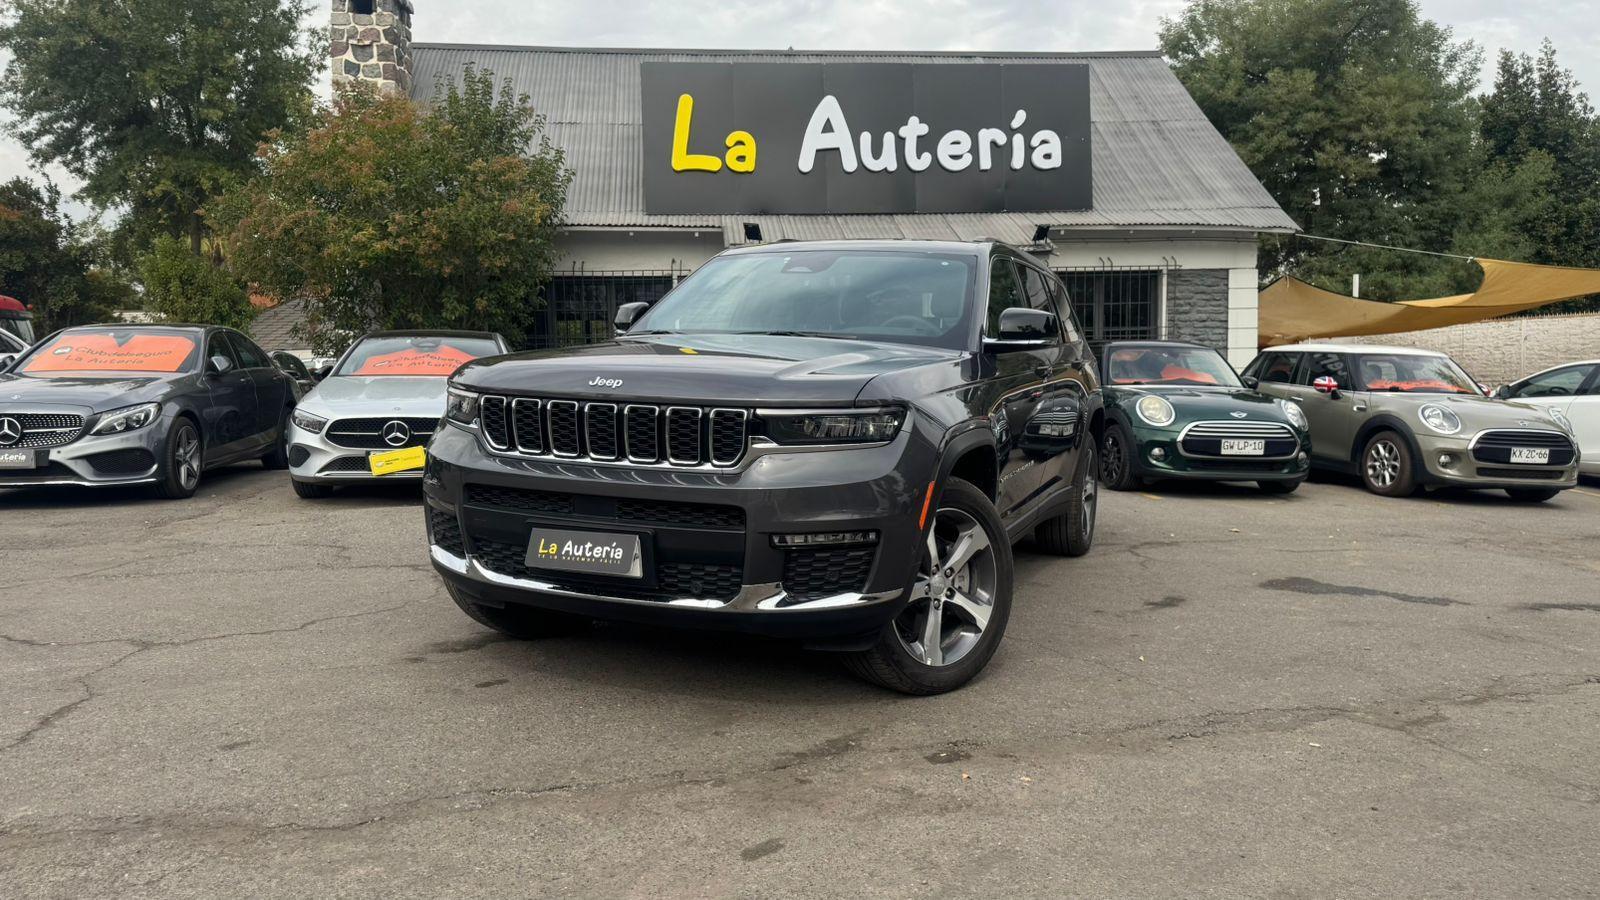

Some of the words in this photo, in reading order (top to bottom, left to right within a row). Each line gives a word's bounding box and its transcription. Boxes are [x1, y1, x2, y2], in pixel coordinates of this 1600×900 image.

[671, 93, 757, 173] La
[798, 94, 1062, 173] Autería
[588, 376, 623, 389] Jeep
[538, 538, 557, 554] La
[562, 540, 623, 559] Autería
